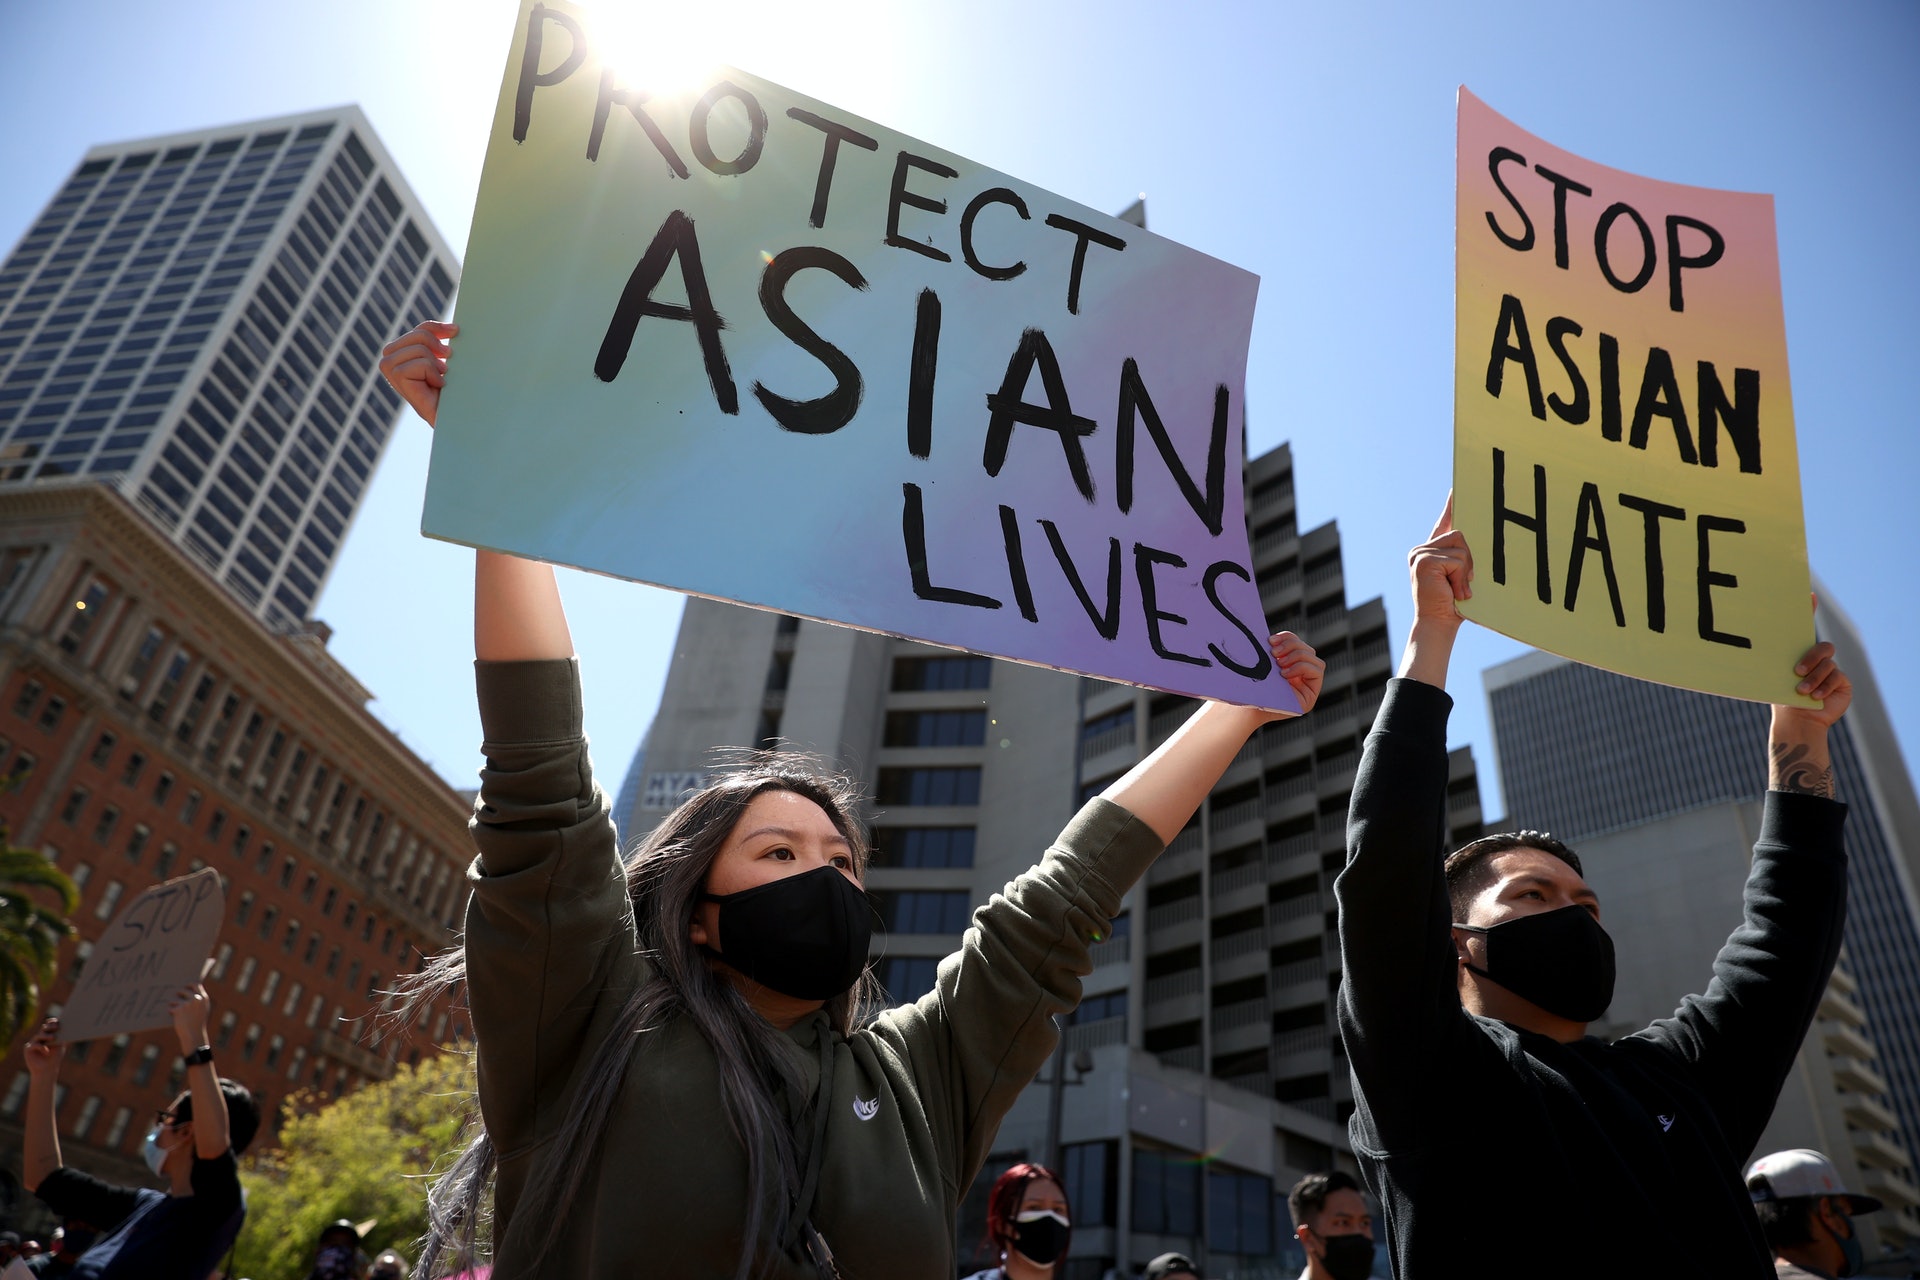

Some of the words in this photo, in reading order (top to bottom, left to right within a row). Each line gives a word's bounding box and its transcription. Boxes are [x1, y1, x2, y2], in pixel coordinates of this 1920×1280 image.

[511, 2, 1126, 315] PROTECT
[1485, 146, 1725, 313] STOP
[593, 208, 1230, 536] ASIAN
[1485, 294, 1762, 475] ASIAN
[901, 481, 1272, 681] LIVES
[1492, 447, 1752, 649] HATE
[84, 948, 169, 992] ASIAN
[113, 874, 215, 952] STOP
[94, 984, 176, 1026] HATE
